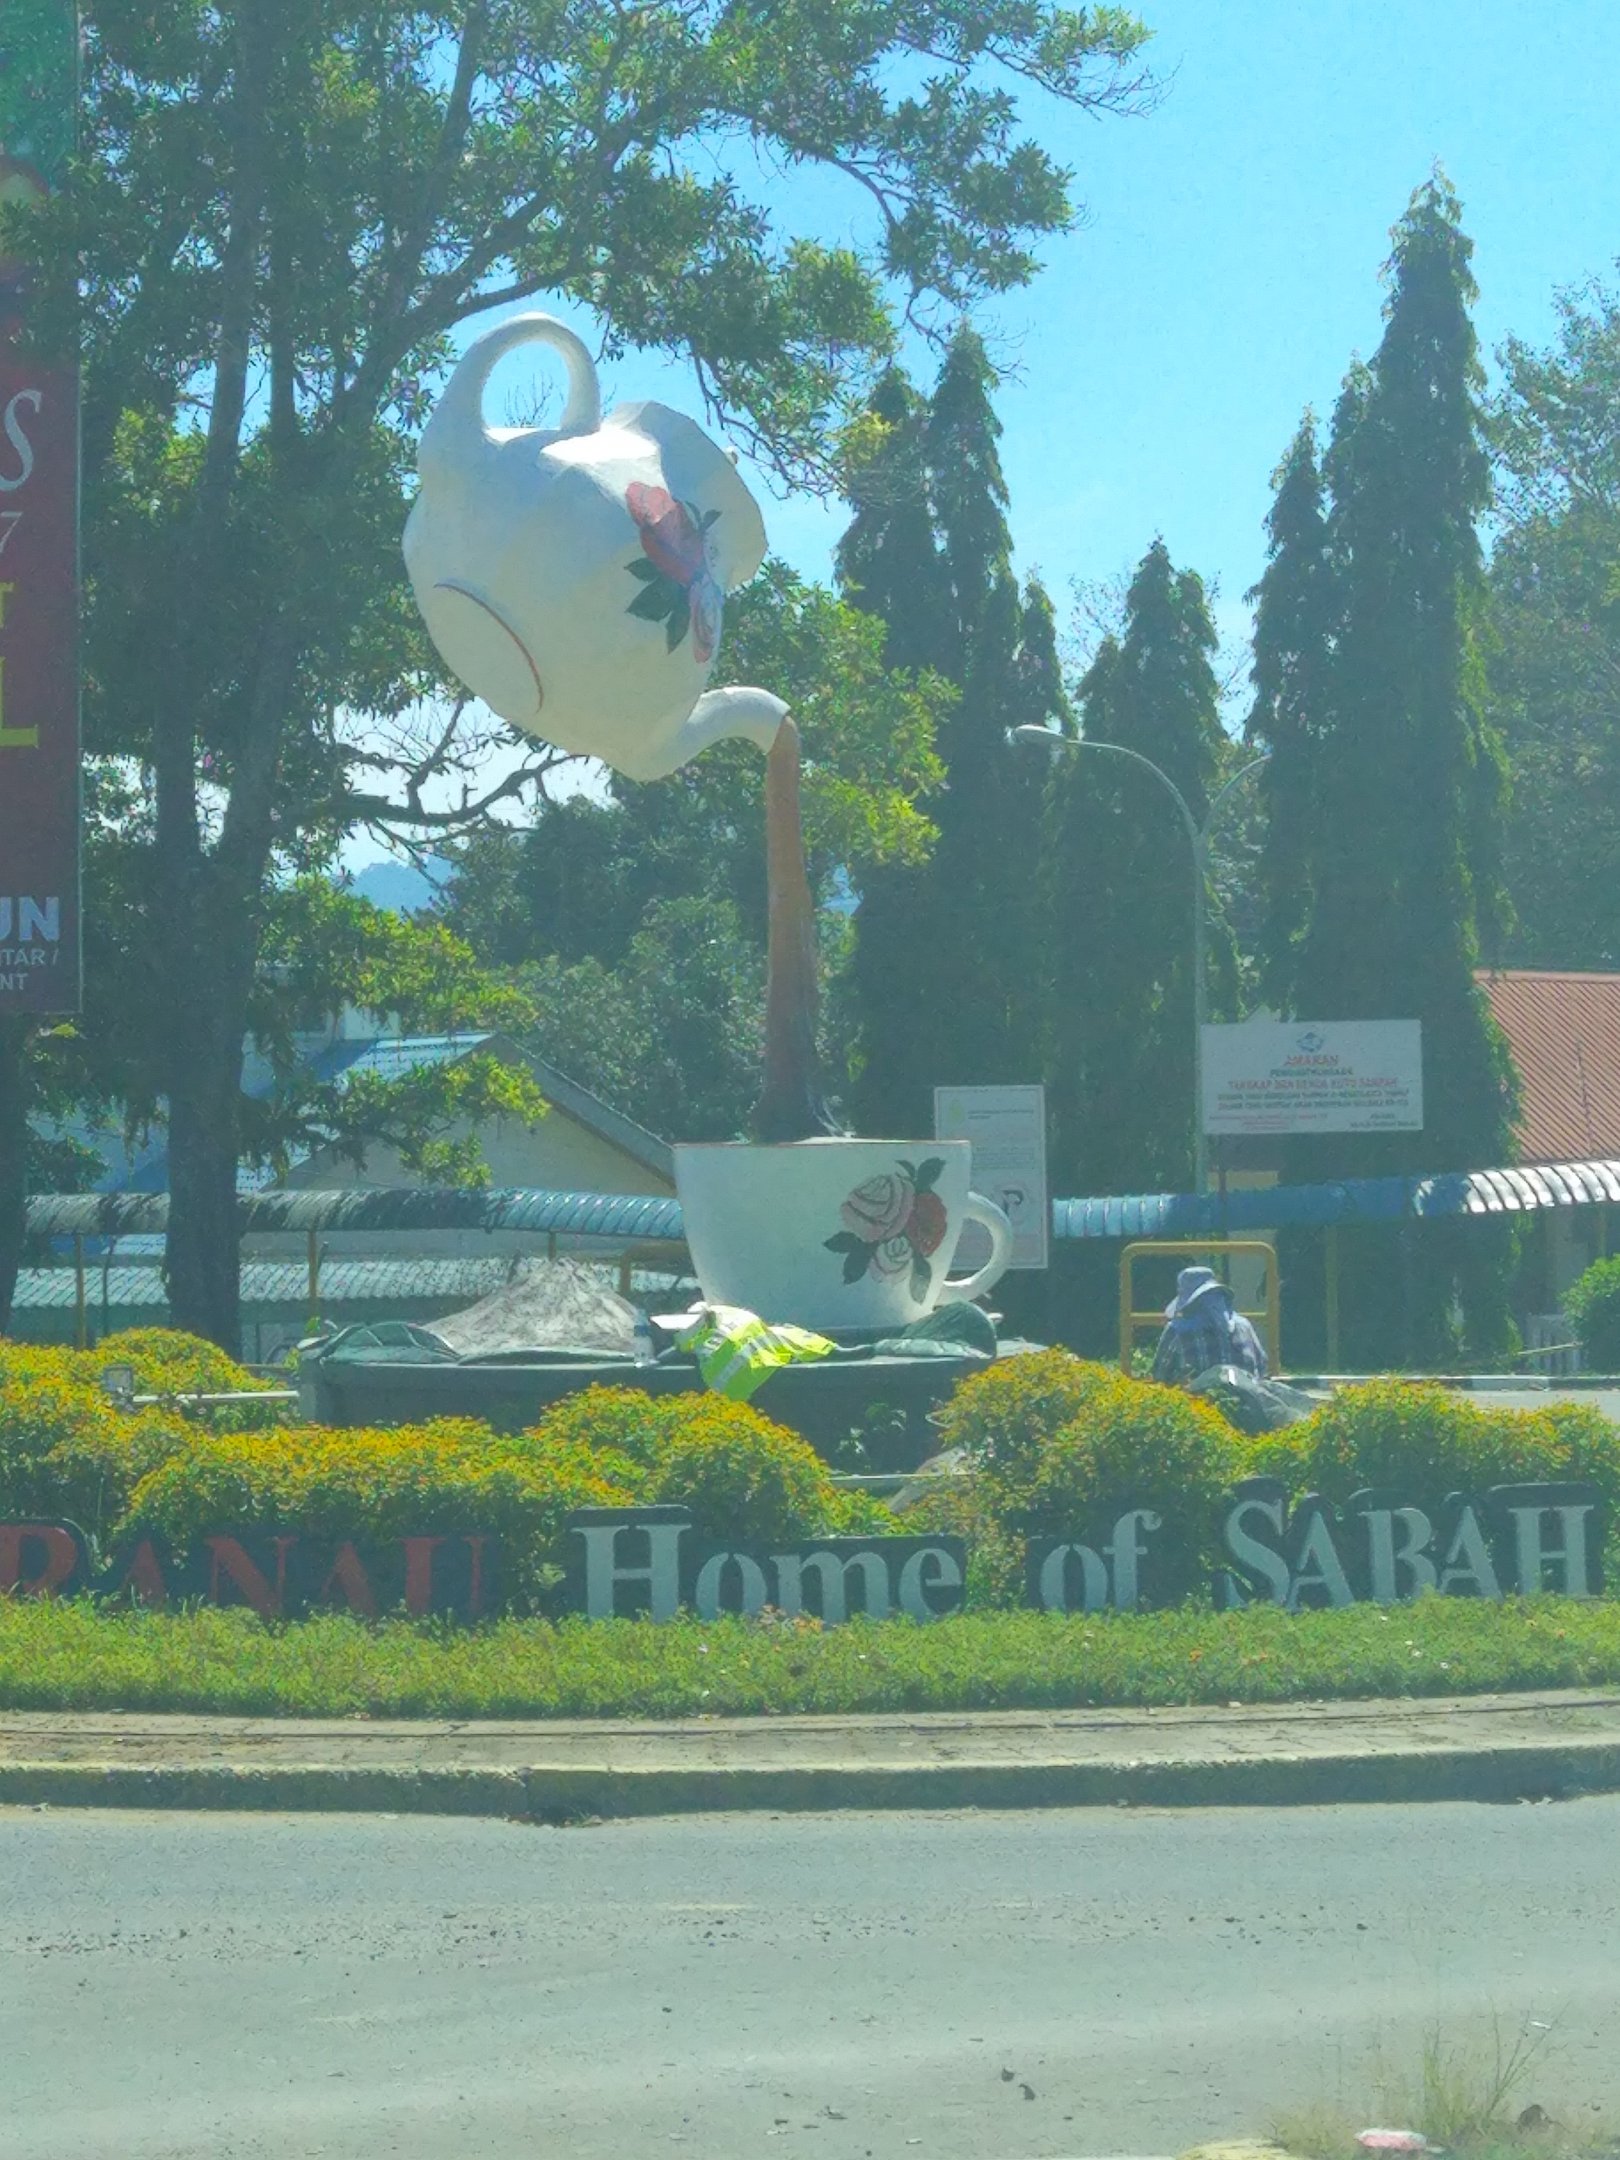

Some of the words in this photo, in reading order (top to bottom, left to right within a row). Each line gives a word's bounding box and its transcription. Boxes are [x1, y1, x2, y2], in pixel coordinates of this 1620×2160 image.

[571, 1524, 962, 1626] Home
[1039, 1509, 1162, 1613] of
[1222, 1498, 1594, 1613] SABAH
